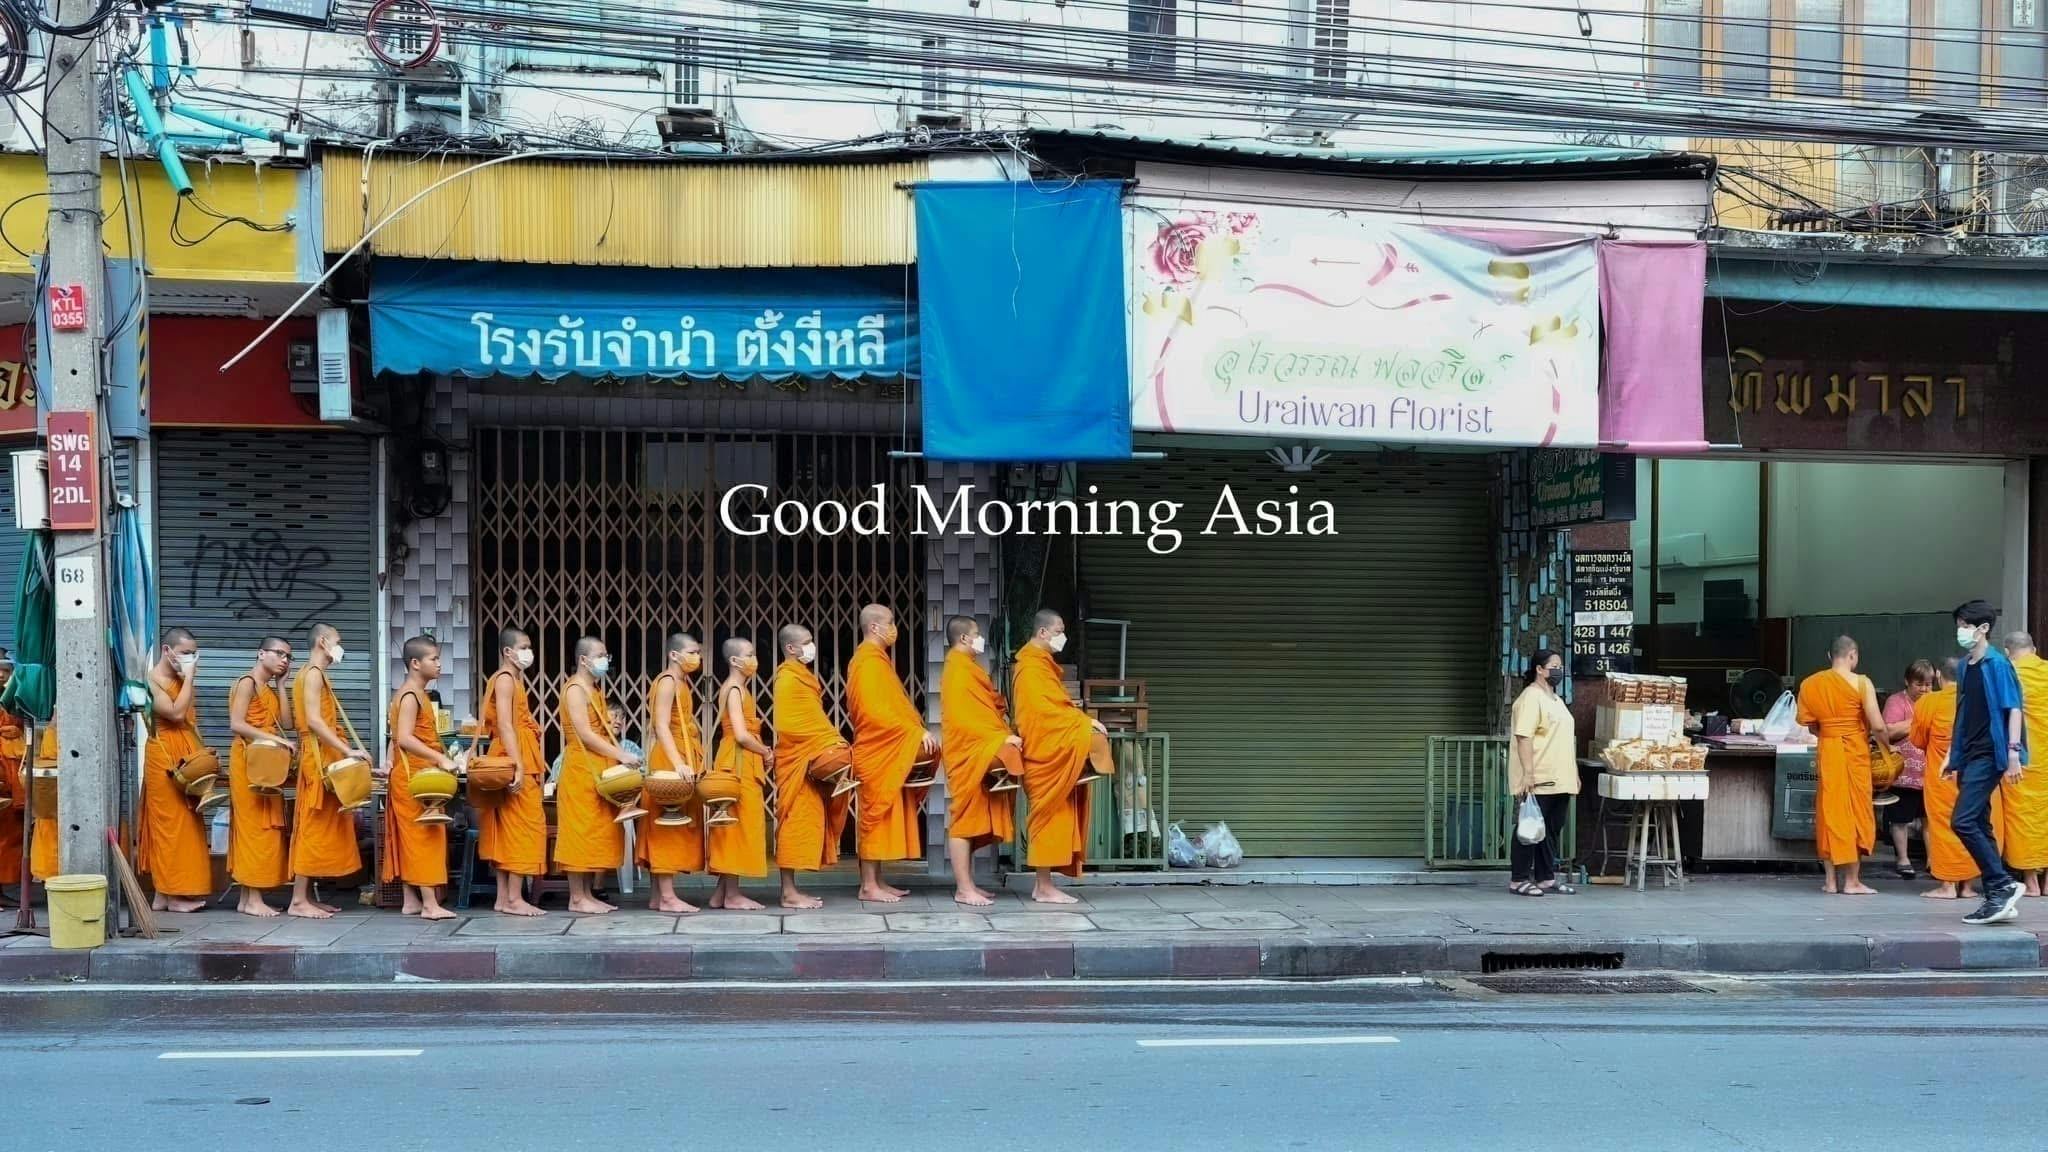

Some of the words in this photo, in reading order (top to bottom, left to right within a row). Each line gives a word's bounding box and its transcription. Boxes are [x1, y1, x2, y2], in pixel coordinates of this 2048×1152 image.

[52, 298, 82, 311] KTL
[53, 312, 83, 326] 0355
[471, 311, 716, 367] โรงรับจำนำ
[736, 308, 886, 366] ตั้งงี่หลี
[1213, 338, 1361, 392] อุไรวรรณ
[1728, 347, 1967, 416] ทิพมาลา
[1238, 389, 1377, 428] Uraiwan
[50, 434, 90, 451] SWG
[58, 454, 82, 472] 14
[53, 486, 91, 504] 2DL
[61, 567, 85, 583] 68
[1584, 599, 1628, 611] 518504
[1574, 626, 1596, 638] 428
[1610, 625, 1634, 637] 447
[1574, 642, 1596, 655] 016
[1607, 643, 1631, 655] 426
[1596, 659, 1611, 669] 31
